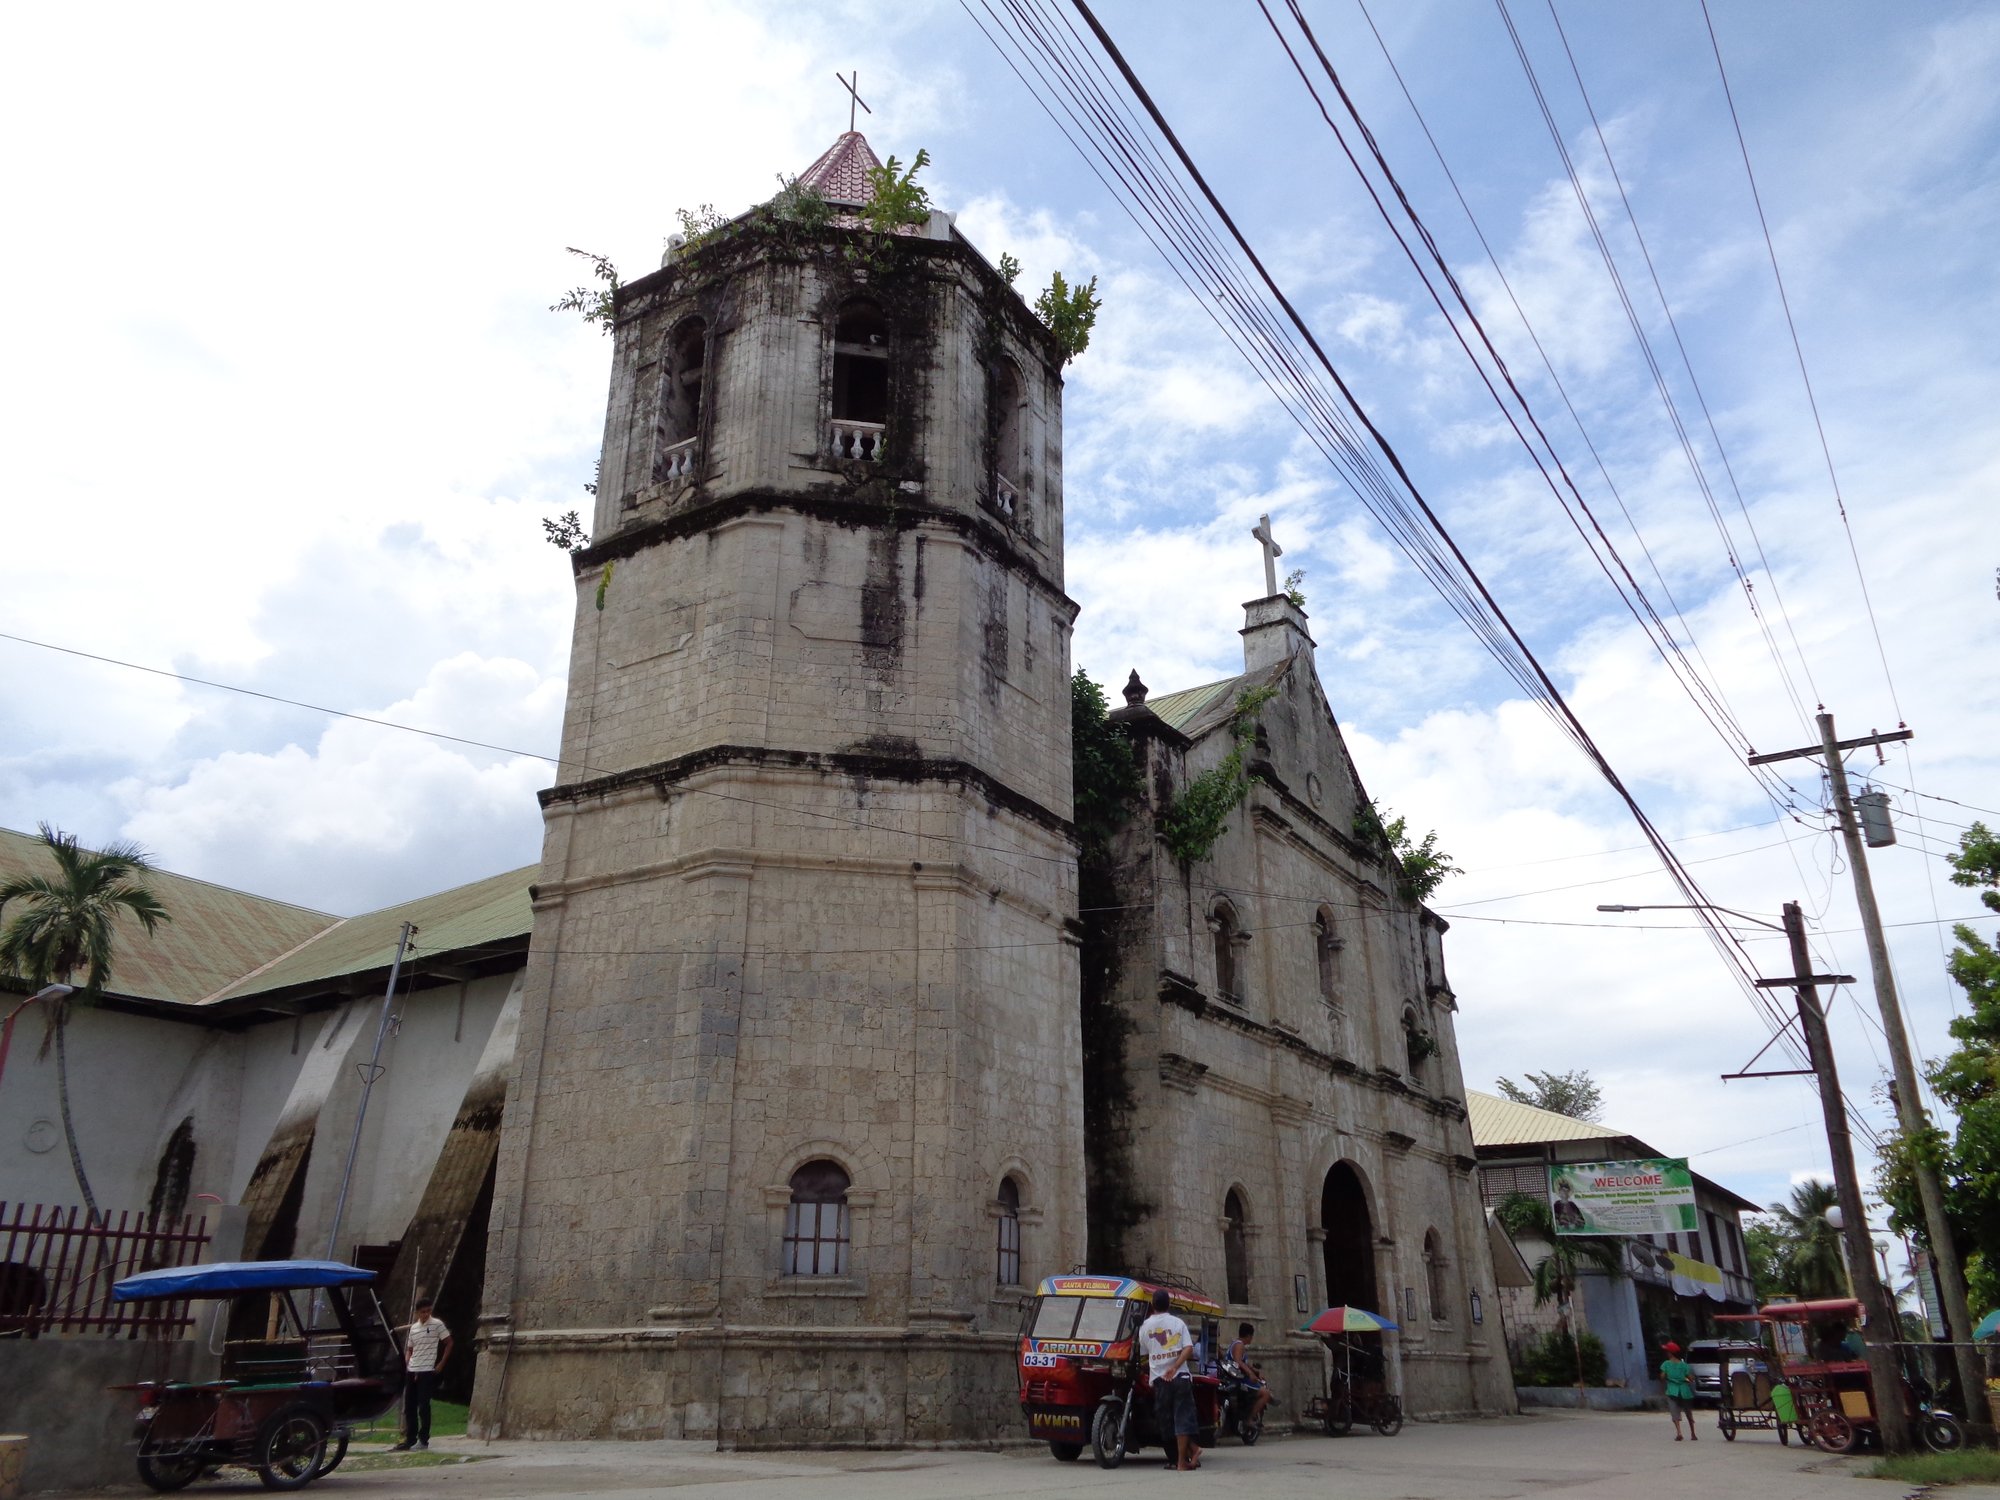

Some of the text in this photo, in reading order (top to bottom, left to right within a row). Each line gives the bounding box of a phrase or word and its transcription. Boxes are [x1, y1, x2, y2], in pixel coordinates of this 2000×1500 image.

[1595, 1174, 1662, 1187] WELCOME
[1062, 1281, 1082, 1289] SANTA
[1041, 1343, 1096, 1355] ARRIANA
[1024, 1356, 1056, 1366] 03-31
